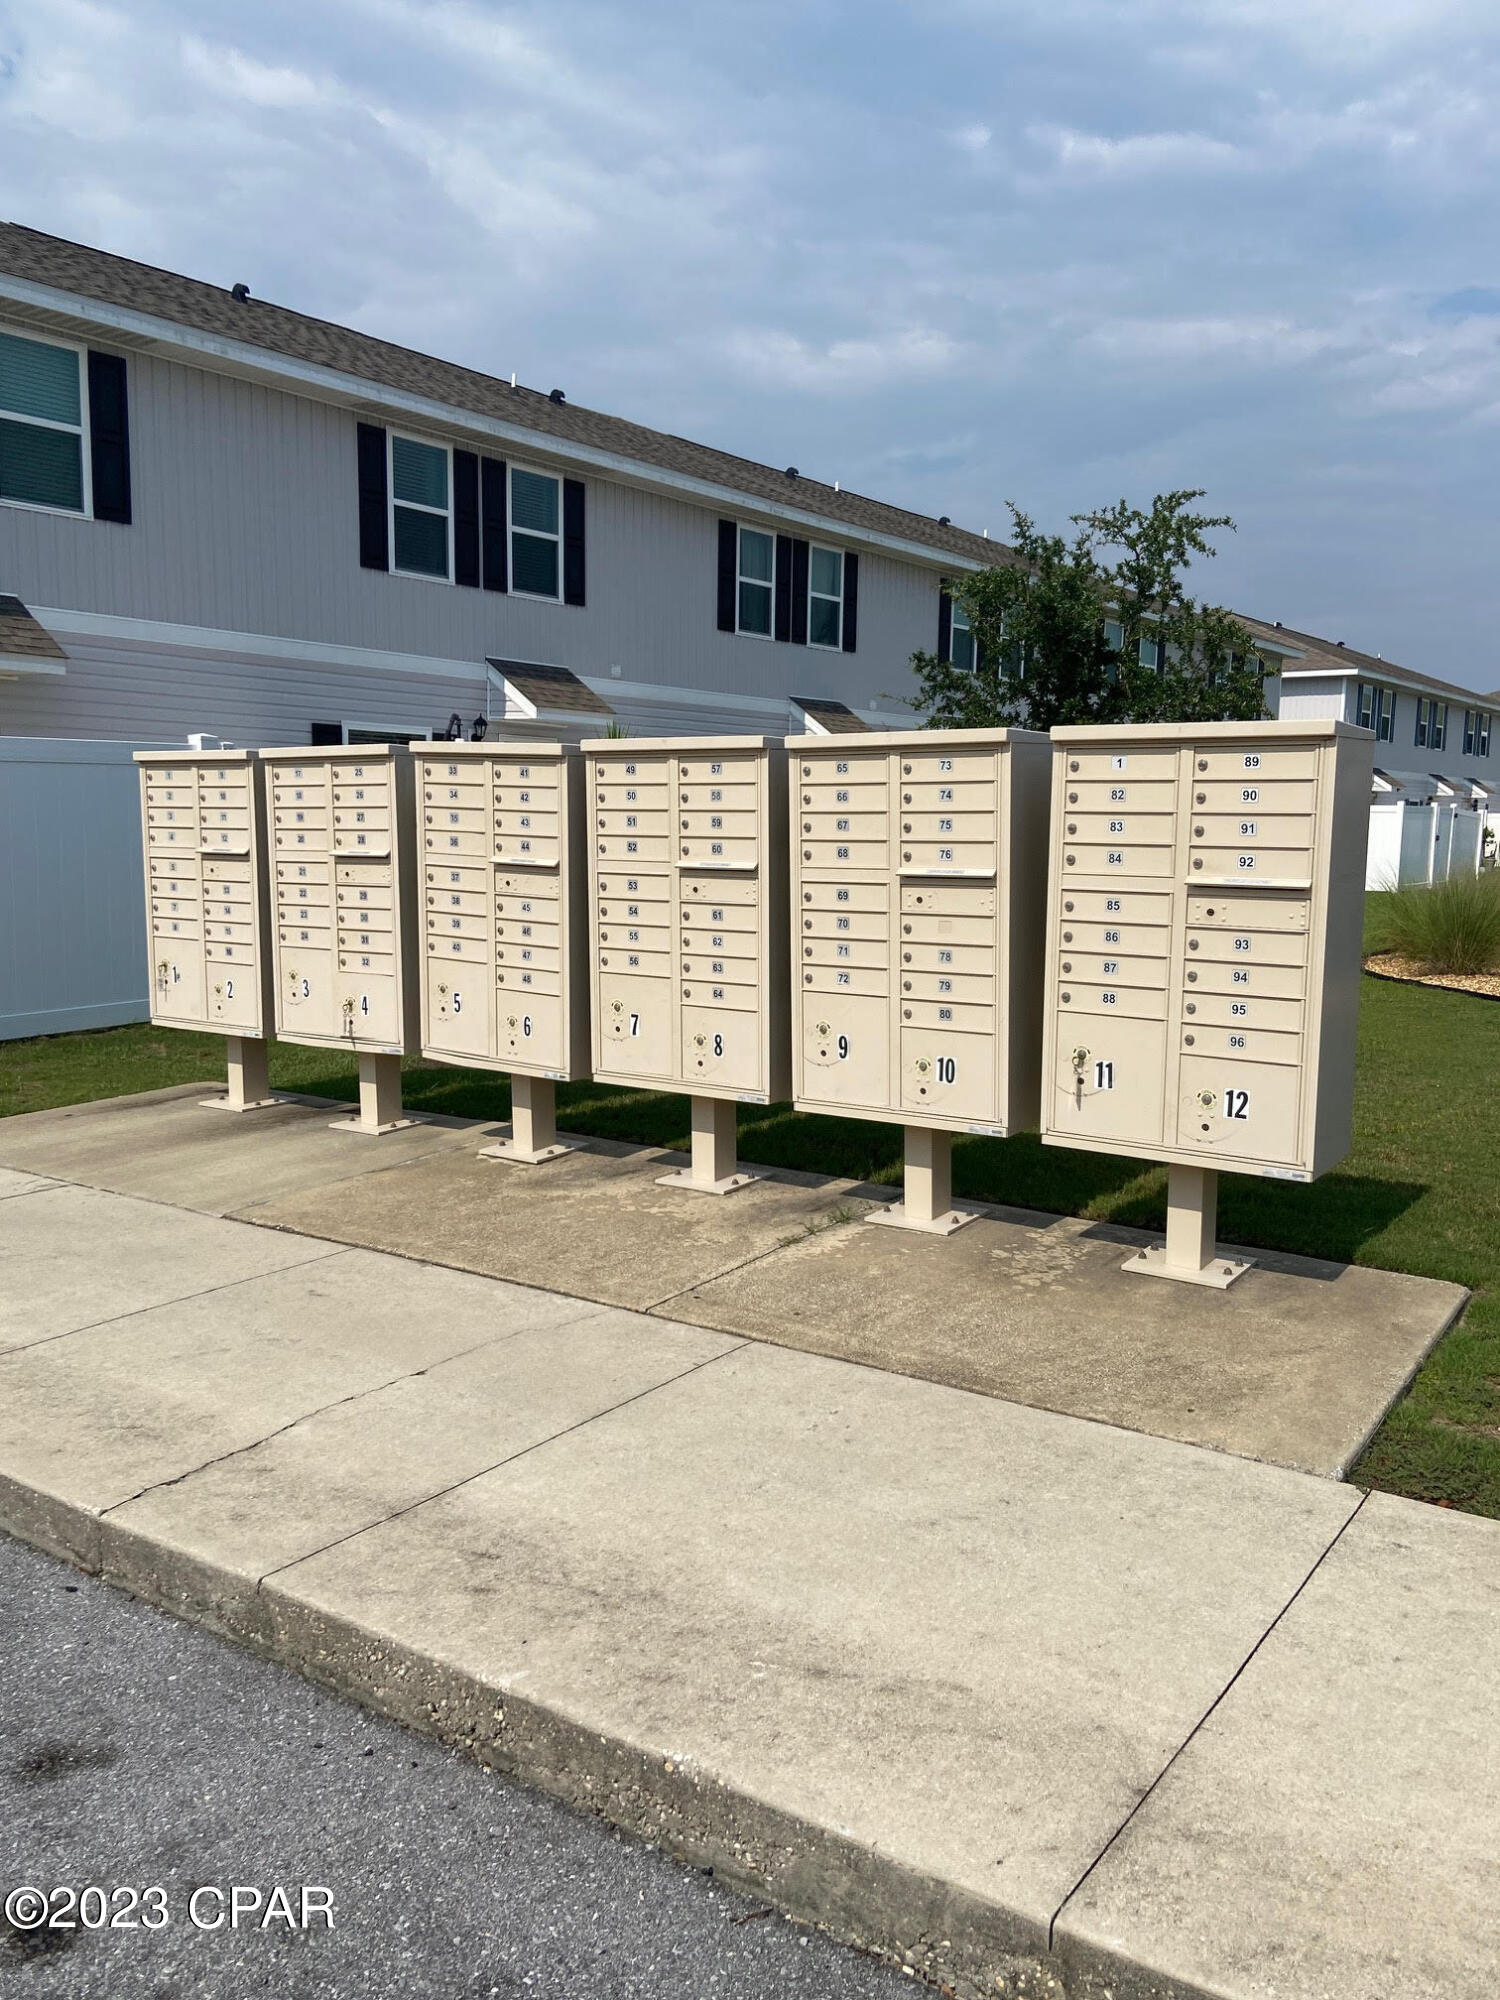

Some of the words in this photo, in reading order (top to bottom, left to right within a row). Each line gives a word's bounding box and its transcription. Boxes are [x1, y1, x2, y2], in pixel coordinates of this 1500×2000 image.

[940, 760, 952, 771] 73
[1244, 756, 1260, 768] 89
[449, 766, 457, 775] 33
[520, 769, 528, 777] 41
[626, 765, 635, 774] 49
[711, 764, 721, 774] 57
[836, 763, 848, 773] 65
[449, 790, 458, 799] 34
[520, 793, 529, 802] 42
[627, 791, 636, 801] 50
[711, 791, 721, 801] 58
[836, 792, 848, 802] 66
[940, 790, 952, 800] 74
[1111, 789, 1125, 800] 82
[1242, 790, 1257, 801] 90
[520, 818, 530, 827] 43
[627, 817, 636, 827] 51
[711, 818, 722, 827] 59
[837, 820, 848, 830] 67
[939, 819, 952, 830] 75
[1110, 821, 1123, 832] 83
[1240, 823, 1254, 834] 91
[521, 842, 530, 850] 44
[627, 842, 637, 852] 52
[711, 844, 722, 854] 60
[837, 848, 849, 858] 68
[939, 849, 951, 860] 76
[1108, 853, 1122, 864] 84
[1239, 856, 1254, 868] 92
[628, 881, 638, 890] 53
[452, 896, 461, 905] 38
[837, 890, 849, 901] 69
[522, 903, 531, 912] 45
[629, 906, 638, 915] 54
[1106, 900, 1120, 911] 85
[712, 910, 722, 920] 61
[452, 919, 460, 928] 39
[837, 918, 849, 929] 70
[522, 927, 531, 936] 46
[629, 931, 639, 941] 55
[712, 937, 722, 946] 62
[1105, 931, 1119, 943] 86
[452, 943, 461, 952] 40
[1234, 939, 1249, 950] 93
[522, 951, 531, 959] 47
[838, 946, 848, 956] 71
[629, 956, 639, 966] 56
[939, 951, 952, 962] 78
[712, 963, 723, 973] 63
[1103, 962, 1117, 973] 87
[522, 975, 531, 984] 48
[838, 973, 849, 984] 72
[1233, 971, 1248, 983] 94
[227, 980, 233, 999] 2
[302, 979, 310, 998] 3
[939, 980, 951, 991] 79
[713, 989, 723, 998] 64
[1102, 993, 1116, 1004] 88
[361, 996, 369, 1016] 4
[453, 993, 461, 1013] 5
[939, 1009, 951, 1019] 80
[1231, 1004, 1246, 1016] 95
[523, 1016, 531, 1037] 6
[630, 1013, 639, 1036] 7
[714, 1034, 723, 1057] 8
[838, 1035, 848, 1059] 9
[1230, 1036, 1245, 1048] 96
[937, 1057, 955, 1084] 10
[1095, 1061, 1113, 1089] 11
[1225, 1089, 1249, 1120] 12
